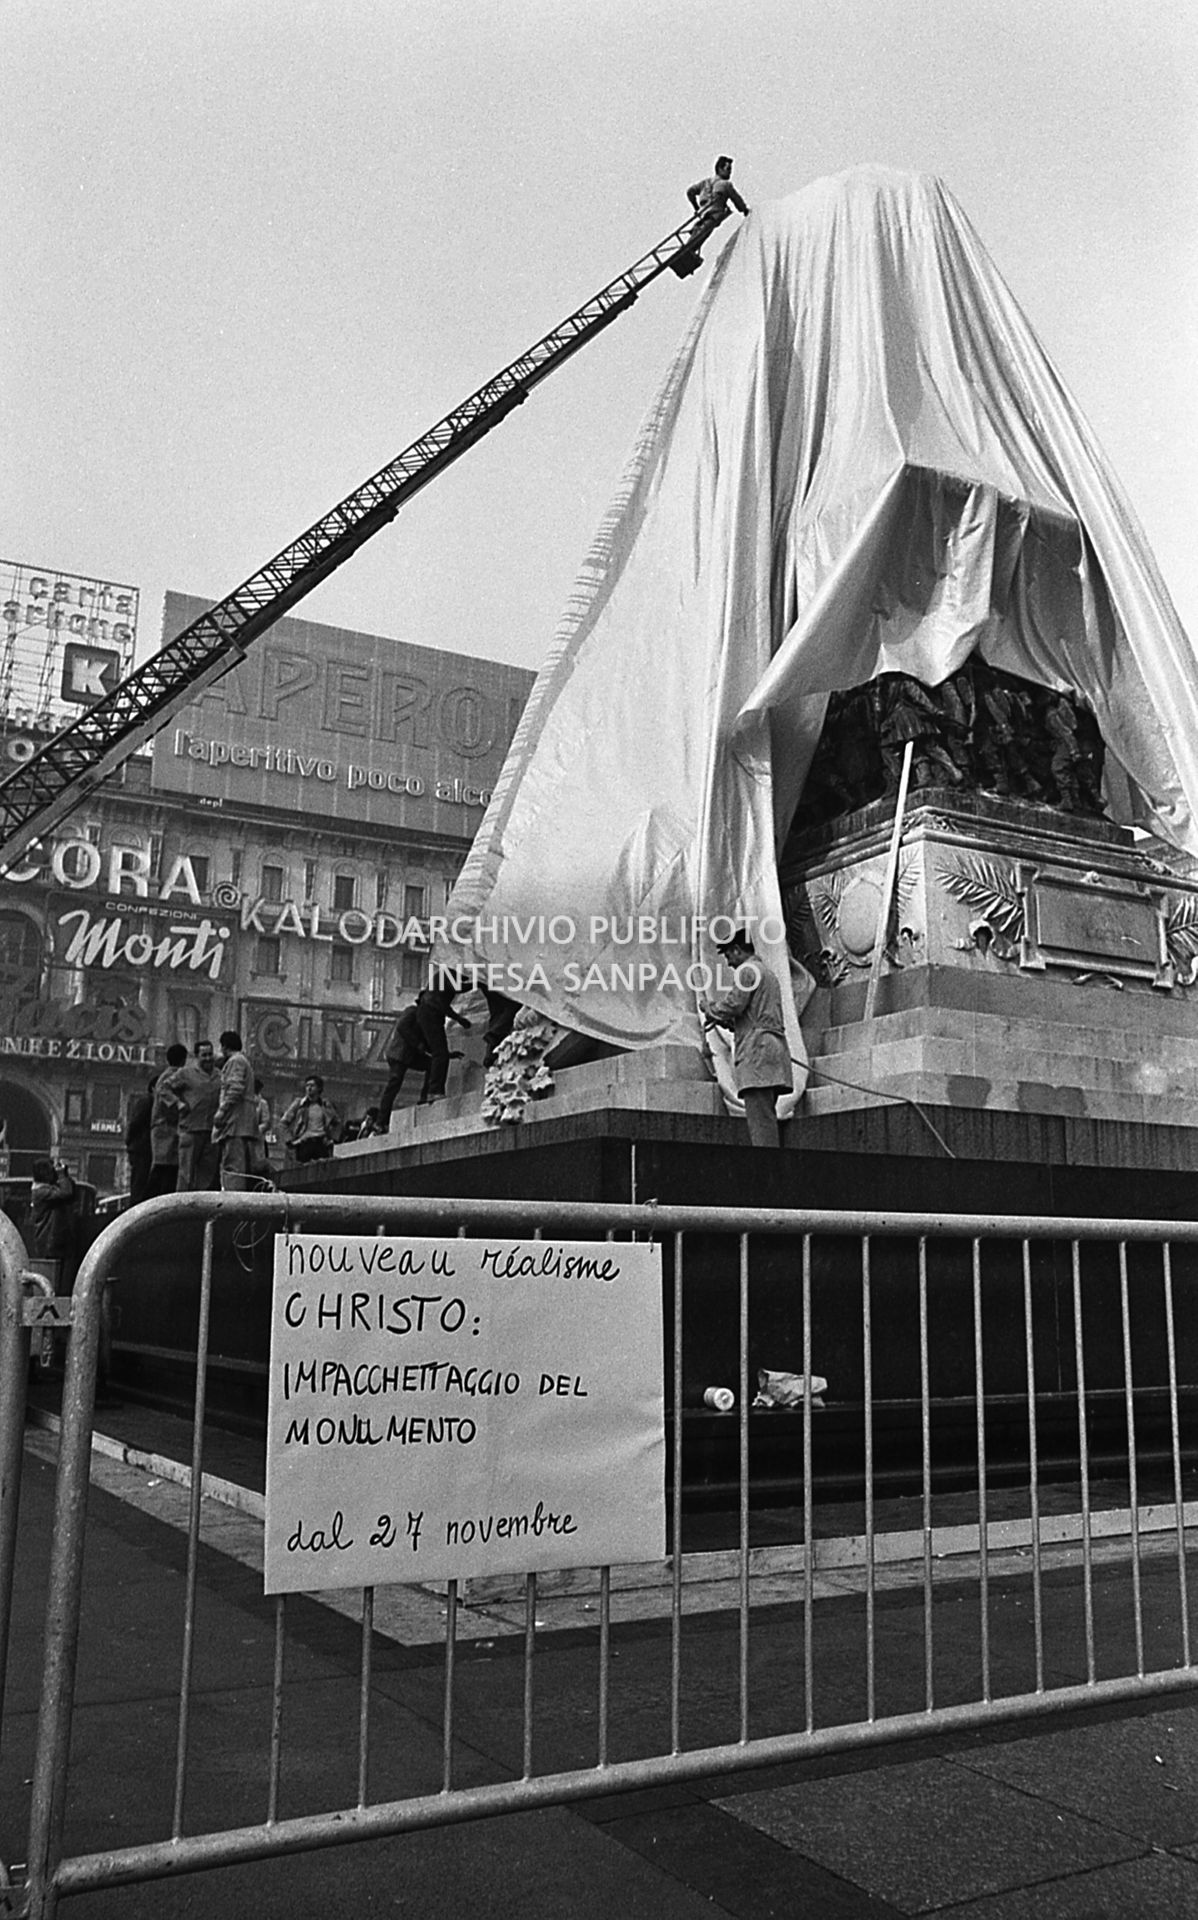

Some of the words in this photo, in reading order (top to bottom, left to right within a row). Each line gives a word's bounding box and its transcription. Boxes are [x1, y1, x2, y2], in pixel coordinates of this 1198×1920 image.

[71, 654, 109, 696] K
[174, 729, 336, 782] l'aperitivo
[348, 763, 425, 797] poco
[105, 901, 197, 920] CONFEZIONI
[58, 909, 231, 979] Monti
[287, 1242, 455, 1276] nouveau
[481, 1246, 621, 1281] réalisme
[285, 1292, 481, 1336] CHRISTO:
[284, 1360, 520, 1400] IMPACCHETTAGGIO
[539, 1373, 588, 1397] DEL
[285, 1413, 476, 1445] MONUMENTO
[287, 1511, 354, 1552] dal
[370, 1511, 424, 1551] 27
[446, 1501, 578, 1545] novembre
